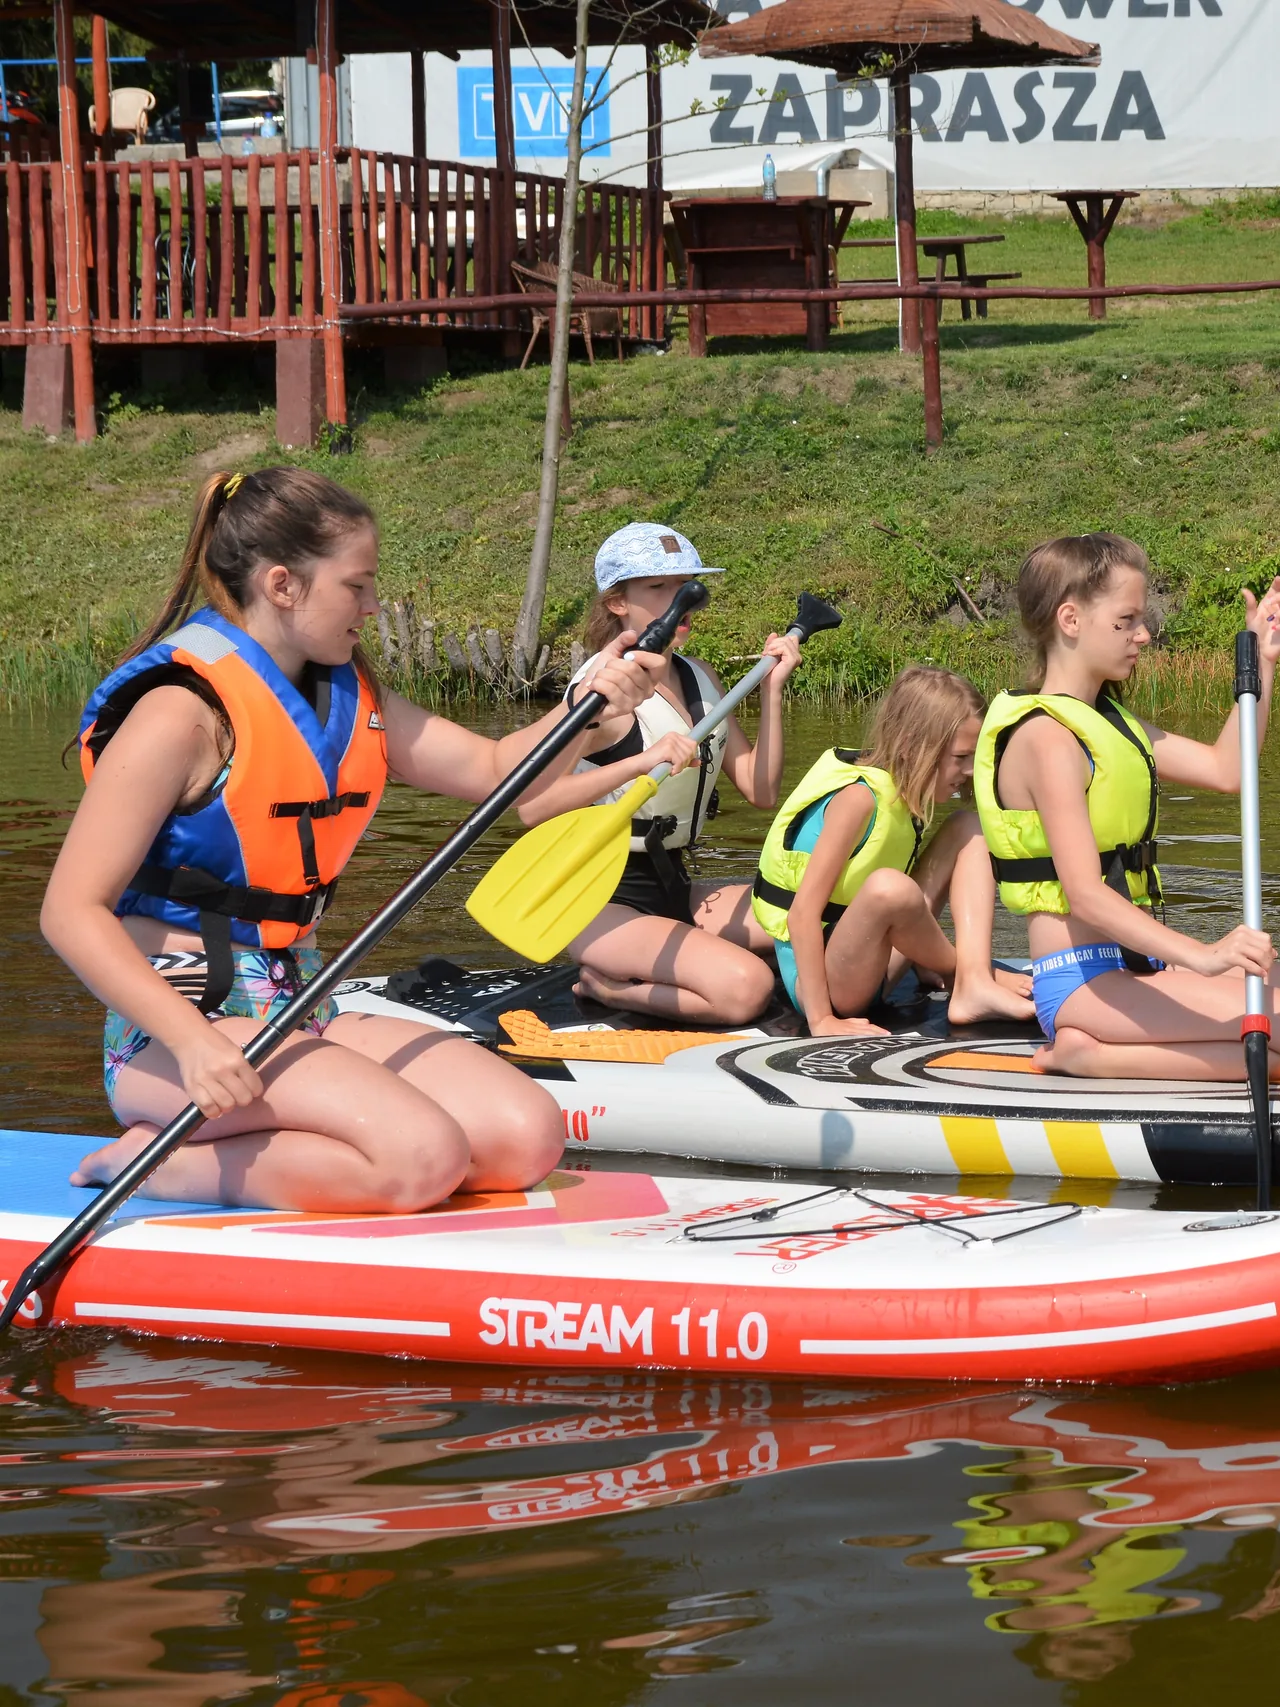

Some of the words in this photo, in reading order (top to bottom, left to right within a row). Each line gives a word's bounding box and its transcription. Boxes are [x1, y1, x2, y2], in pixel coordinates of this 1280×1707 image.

[709, 70, 1167, 144] ZAPRASZA
[1041, 955, 1064, 972] VIBES
[478, 1296, 654, 1356] STREAM
[670, 1306, 769, 1361] 11.0
